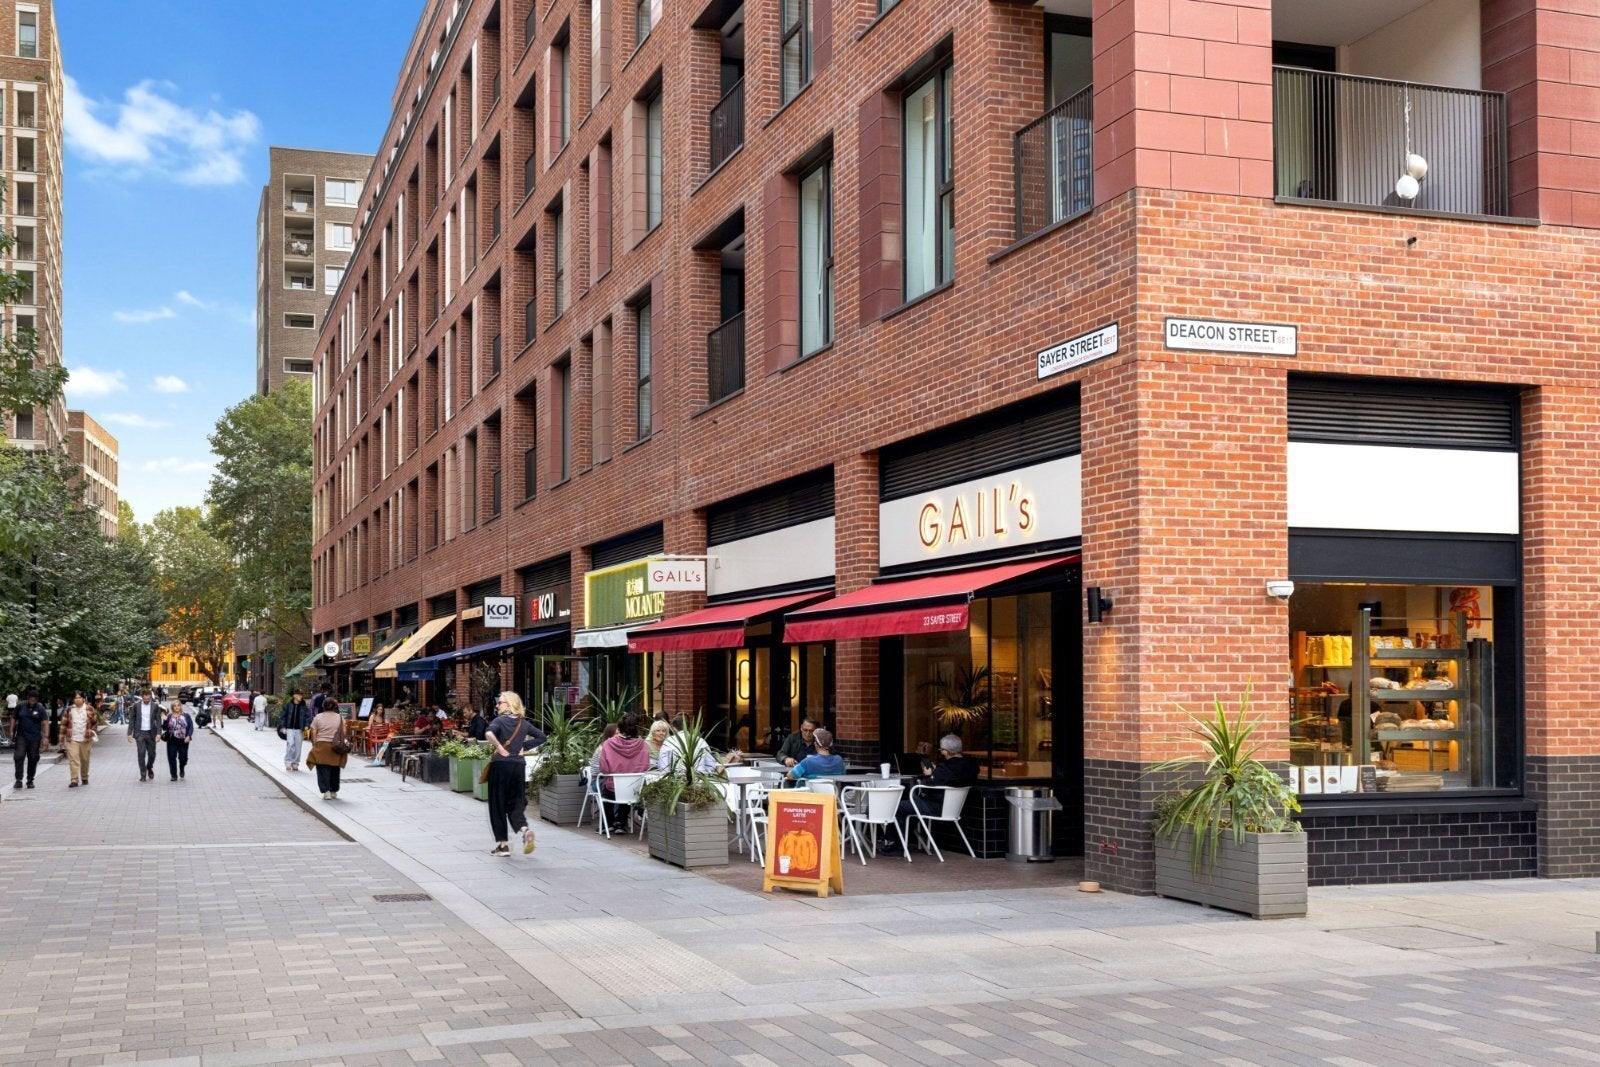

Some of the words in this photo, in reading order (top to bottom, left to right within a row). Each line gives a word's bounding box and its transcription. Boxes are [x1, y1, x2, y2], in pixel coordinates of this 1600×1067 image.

[1170, 323, 1224, 340] DEACON
[1229, 327, 1277, 343] STREET
[1040, 347, 1067, 368] SAYER
[1069, 333, 1104, 357] STREET
[919, 484, 1033, 547] GAIL's
[653, 570, 701, 582] GAIL's
[487, 604, 512, 616] KOI
[538, 592, 554, 620] KOI
[930, 614, 945, 625] SAYER
[945, 612, 962, 624] STREET
